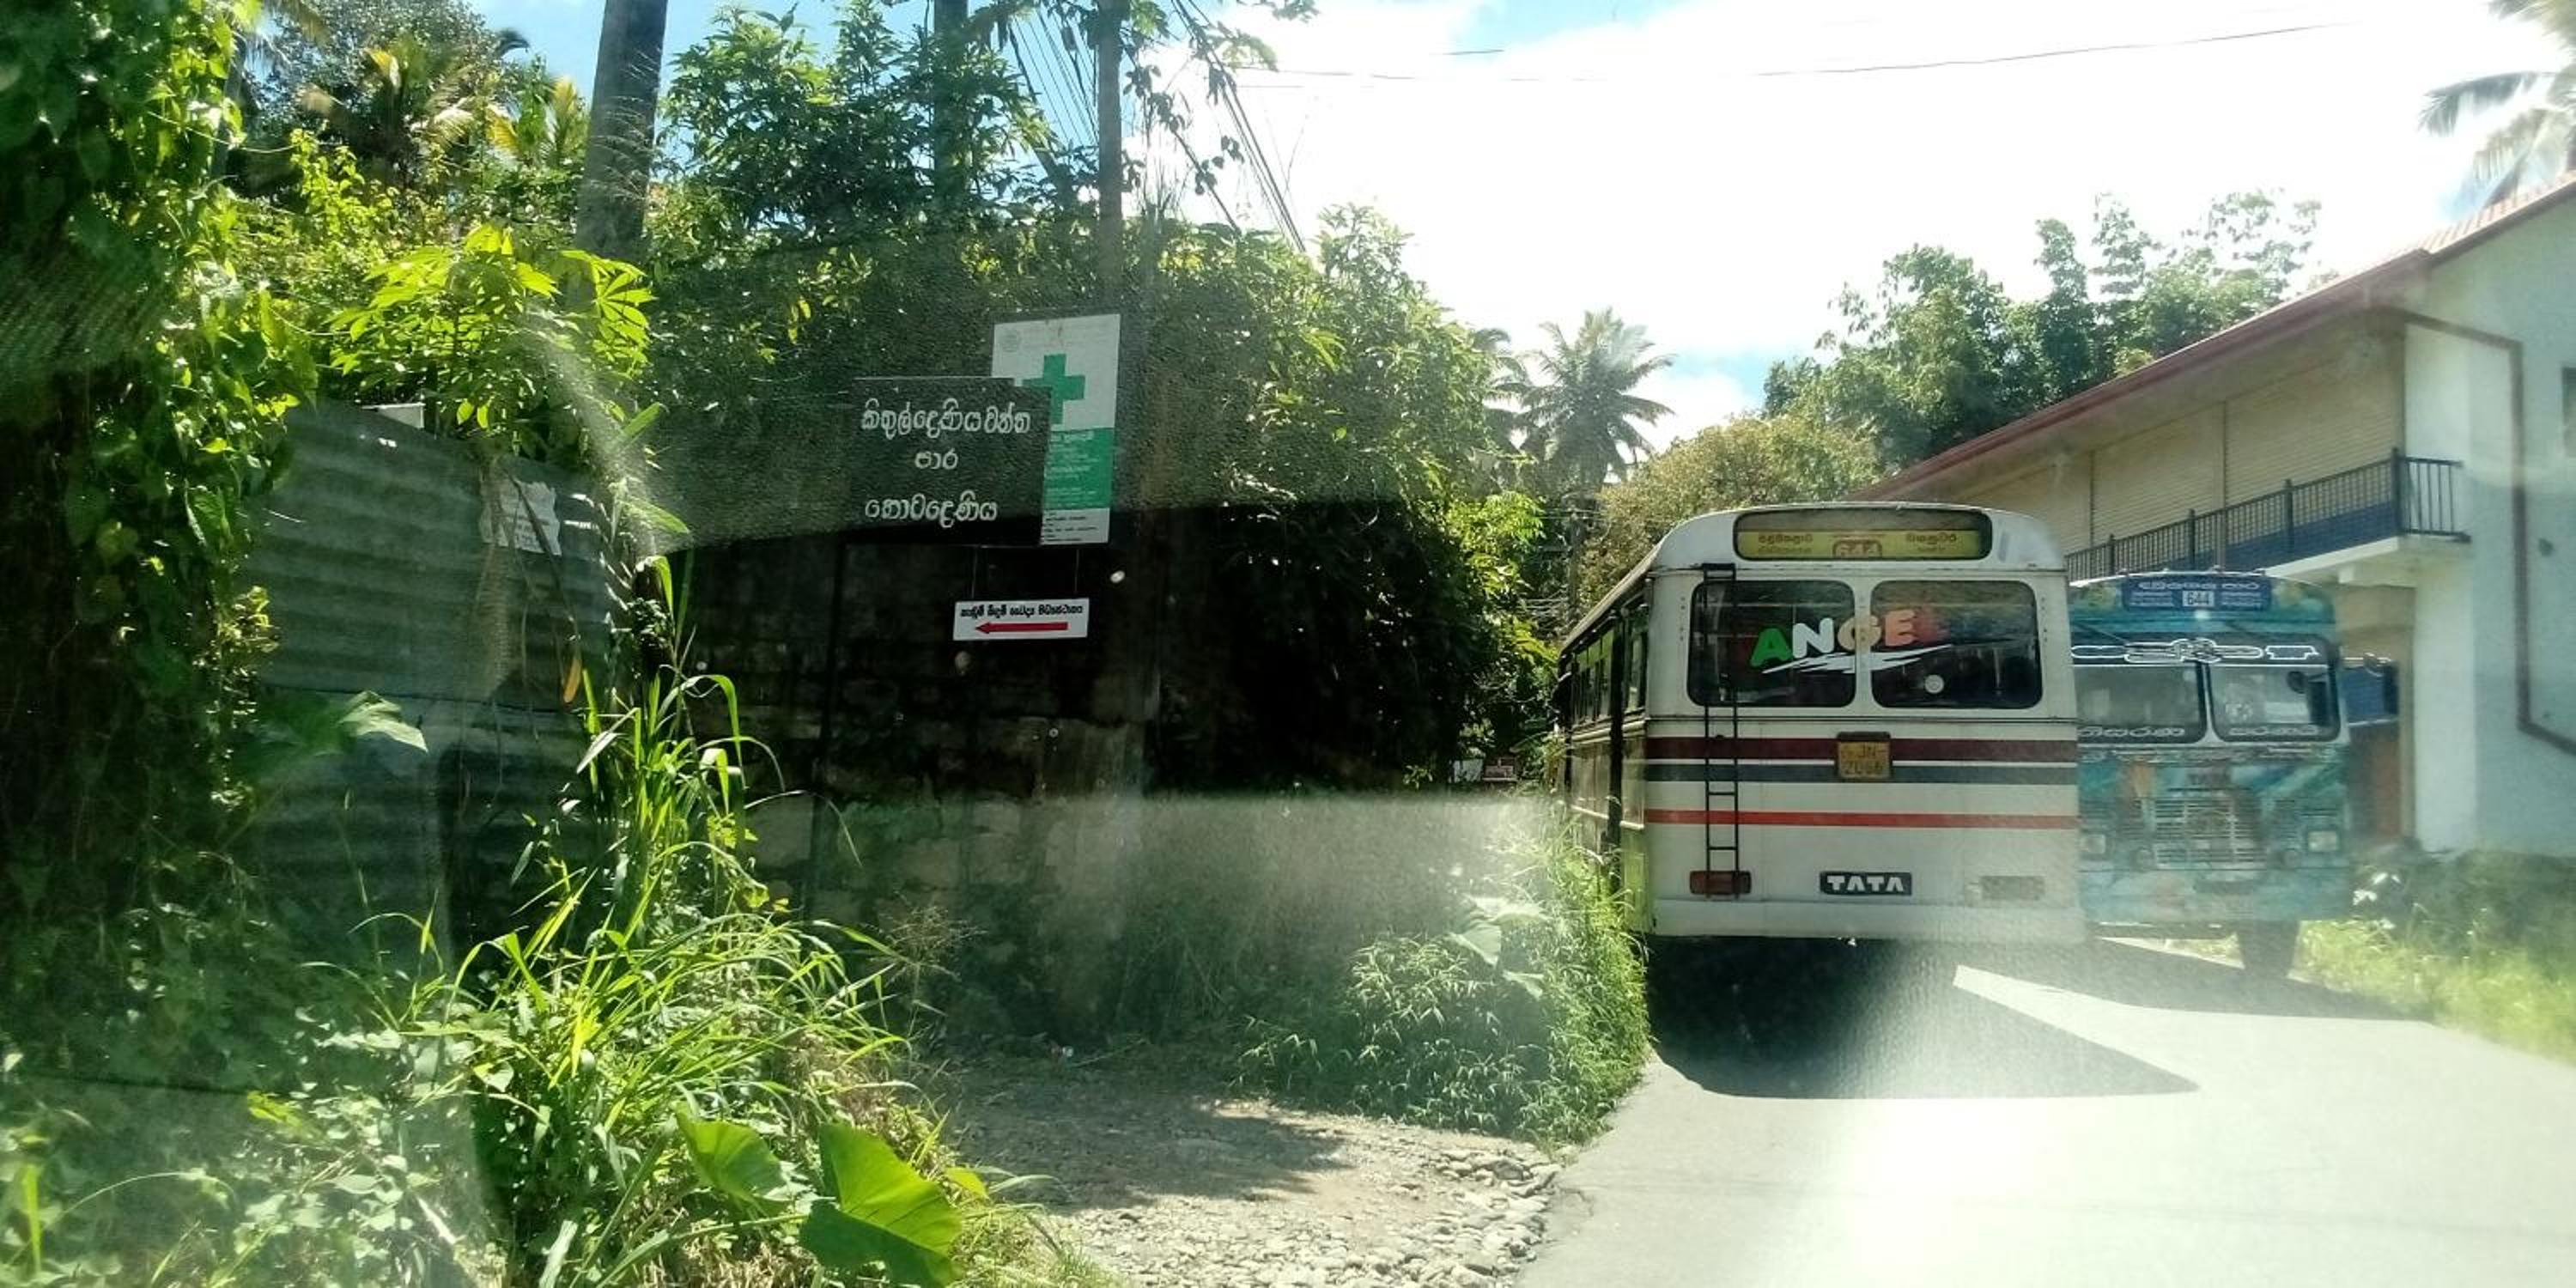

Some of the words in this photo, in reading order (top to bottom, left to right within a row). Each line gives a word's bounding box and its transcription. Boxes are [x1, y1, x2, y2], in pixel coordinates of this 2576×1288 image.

[914, 447, 959, 470] පාර
[1750, 609, 1946, 667] ANGE
[1826, 875, 1904, 892] TATA
